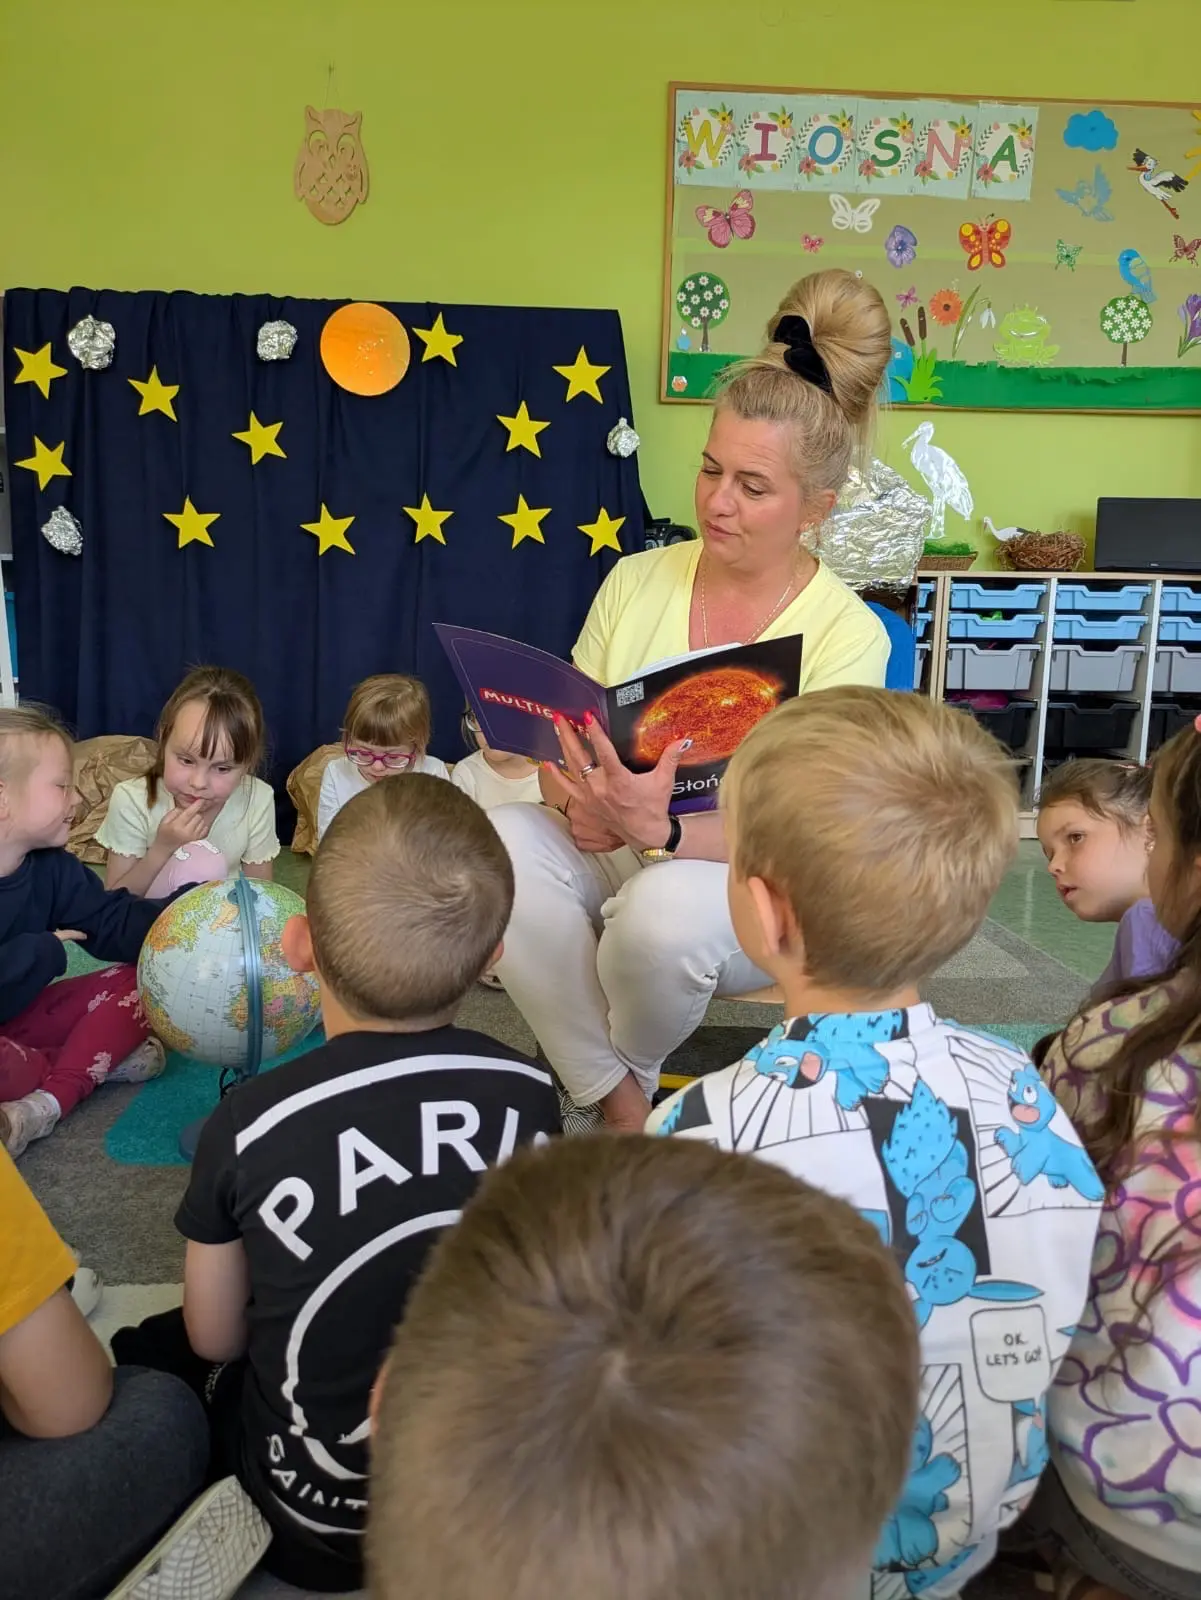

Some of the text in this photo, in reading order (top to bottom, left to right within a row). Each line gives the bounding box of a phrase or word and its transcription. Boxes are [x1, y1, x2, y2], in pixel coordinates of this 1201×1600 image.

[684, 118, 1018, 174] WIOSNA
[671, 773, 723, 795] Słoń
[258, 1100, 548, 1261] PARI
[1004, 1333, 1028, 1346] OK
[986, 1353, 1019, 1366] LET'S
